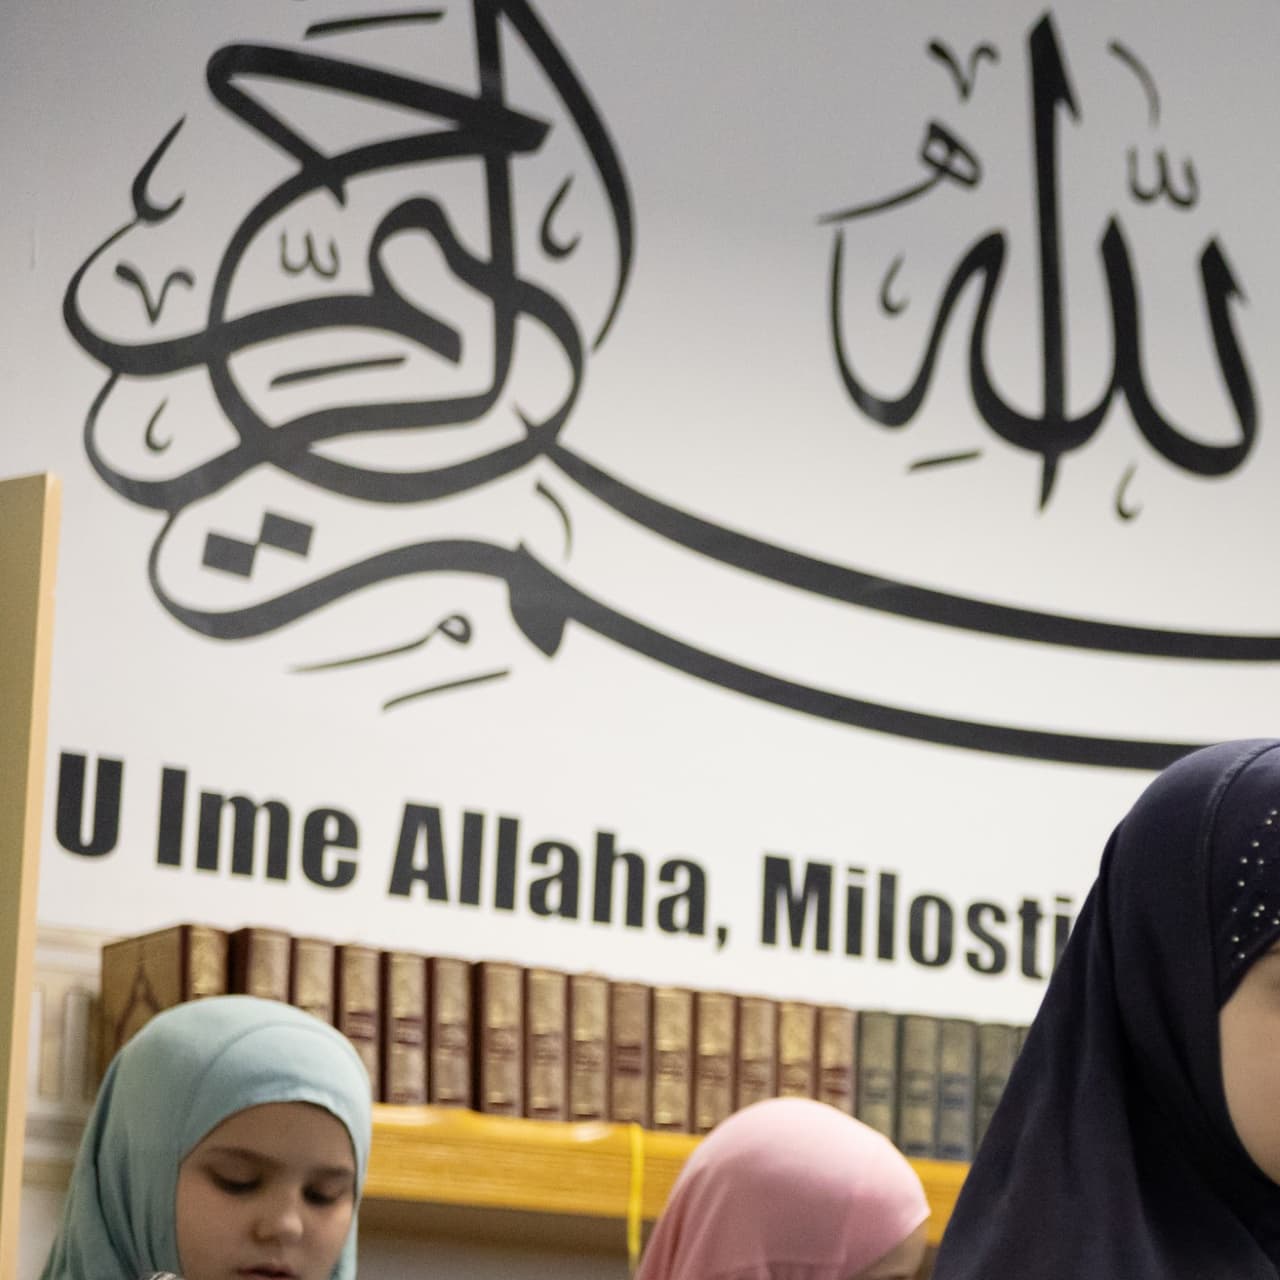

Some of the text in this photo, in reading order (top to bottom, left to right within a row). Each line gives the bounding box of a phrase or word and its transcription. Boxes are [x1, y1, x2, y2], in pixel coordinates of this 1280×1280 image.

[54, 750, 126, 859] U
[155, 765, 362, 890] Ime
[386, 801, 731, 952] Allaha,
[760, 854, 1076, 981] Milosti
